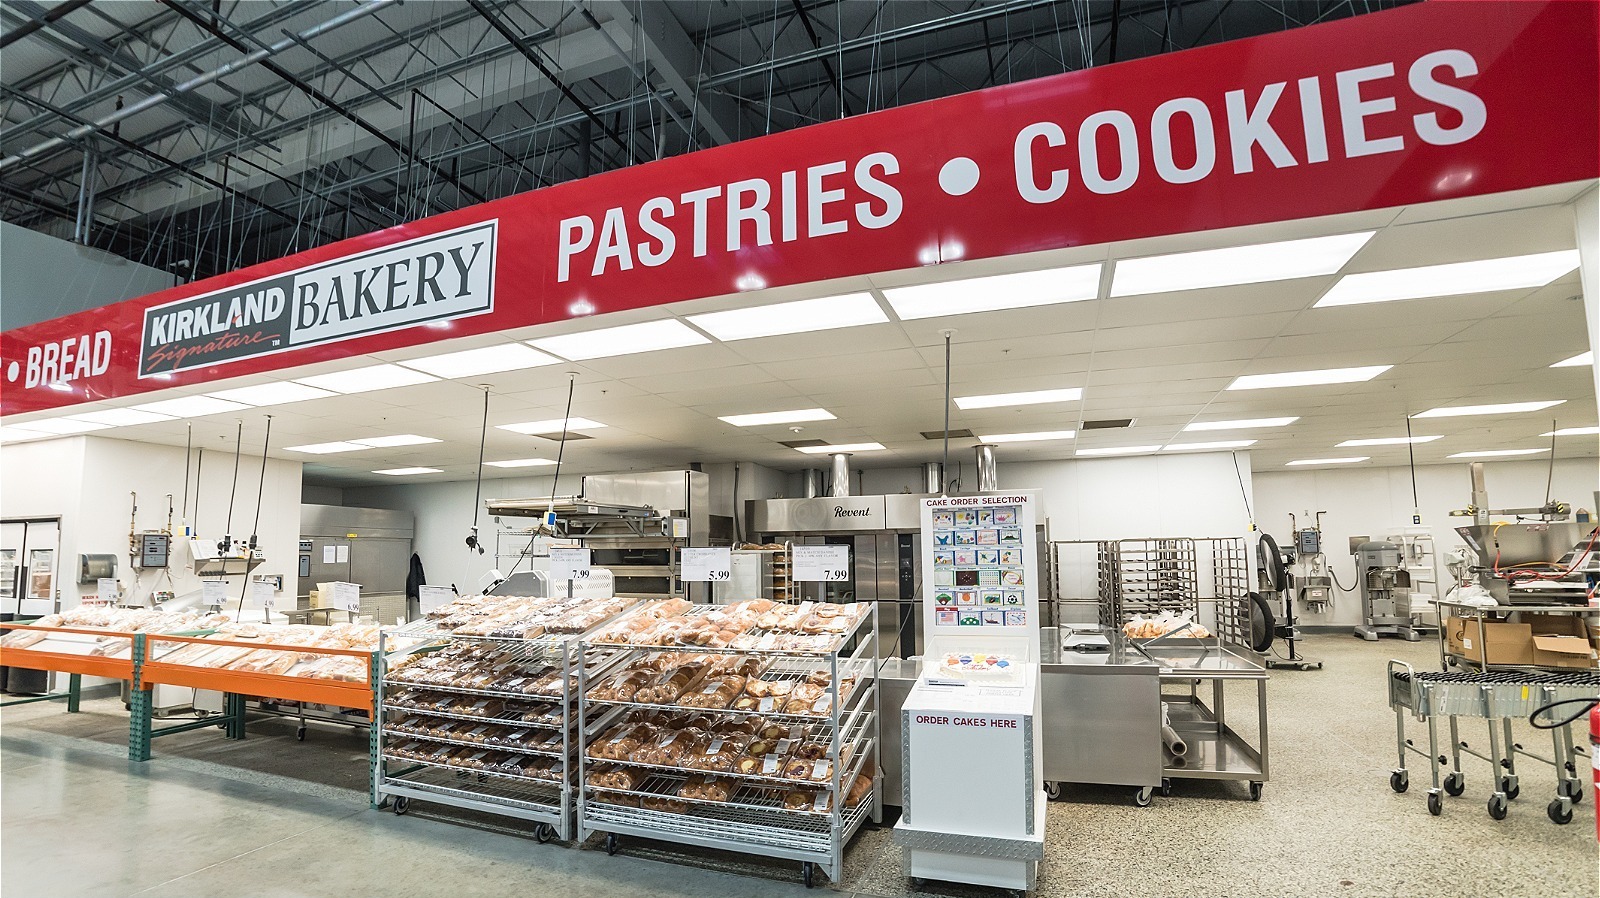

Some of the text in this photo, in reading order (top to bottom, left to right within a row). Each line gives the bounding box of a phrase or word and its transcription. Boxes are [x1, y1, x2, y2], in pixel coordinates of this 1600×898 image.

[557, 48, 1488, 283] PASTRIES COOKIES
[294, 241, 485, 331] BAKERY
[150, 286, 286, 347] KIRKLAND
[147, 330, 281, 372] Signature
[24, 330, 112, 390] BREAD
[926, 496, 1028, 507] CAKE ORDER SELECTION
[833, 505, 870, 518] Revent
[572, 569, 590, 579] 7.99
[708, 570, 730, 580] 5.99
[823, 569, 848, 580] 7.99
[916, 715, 1017, 728] ORDER CAKES HERE
